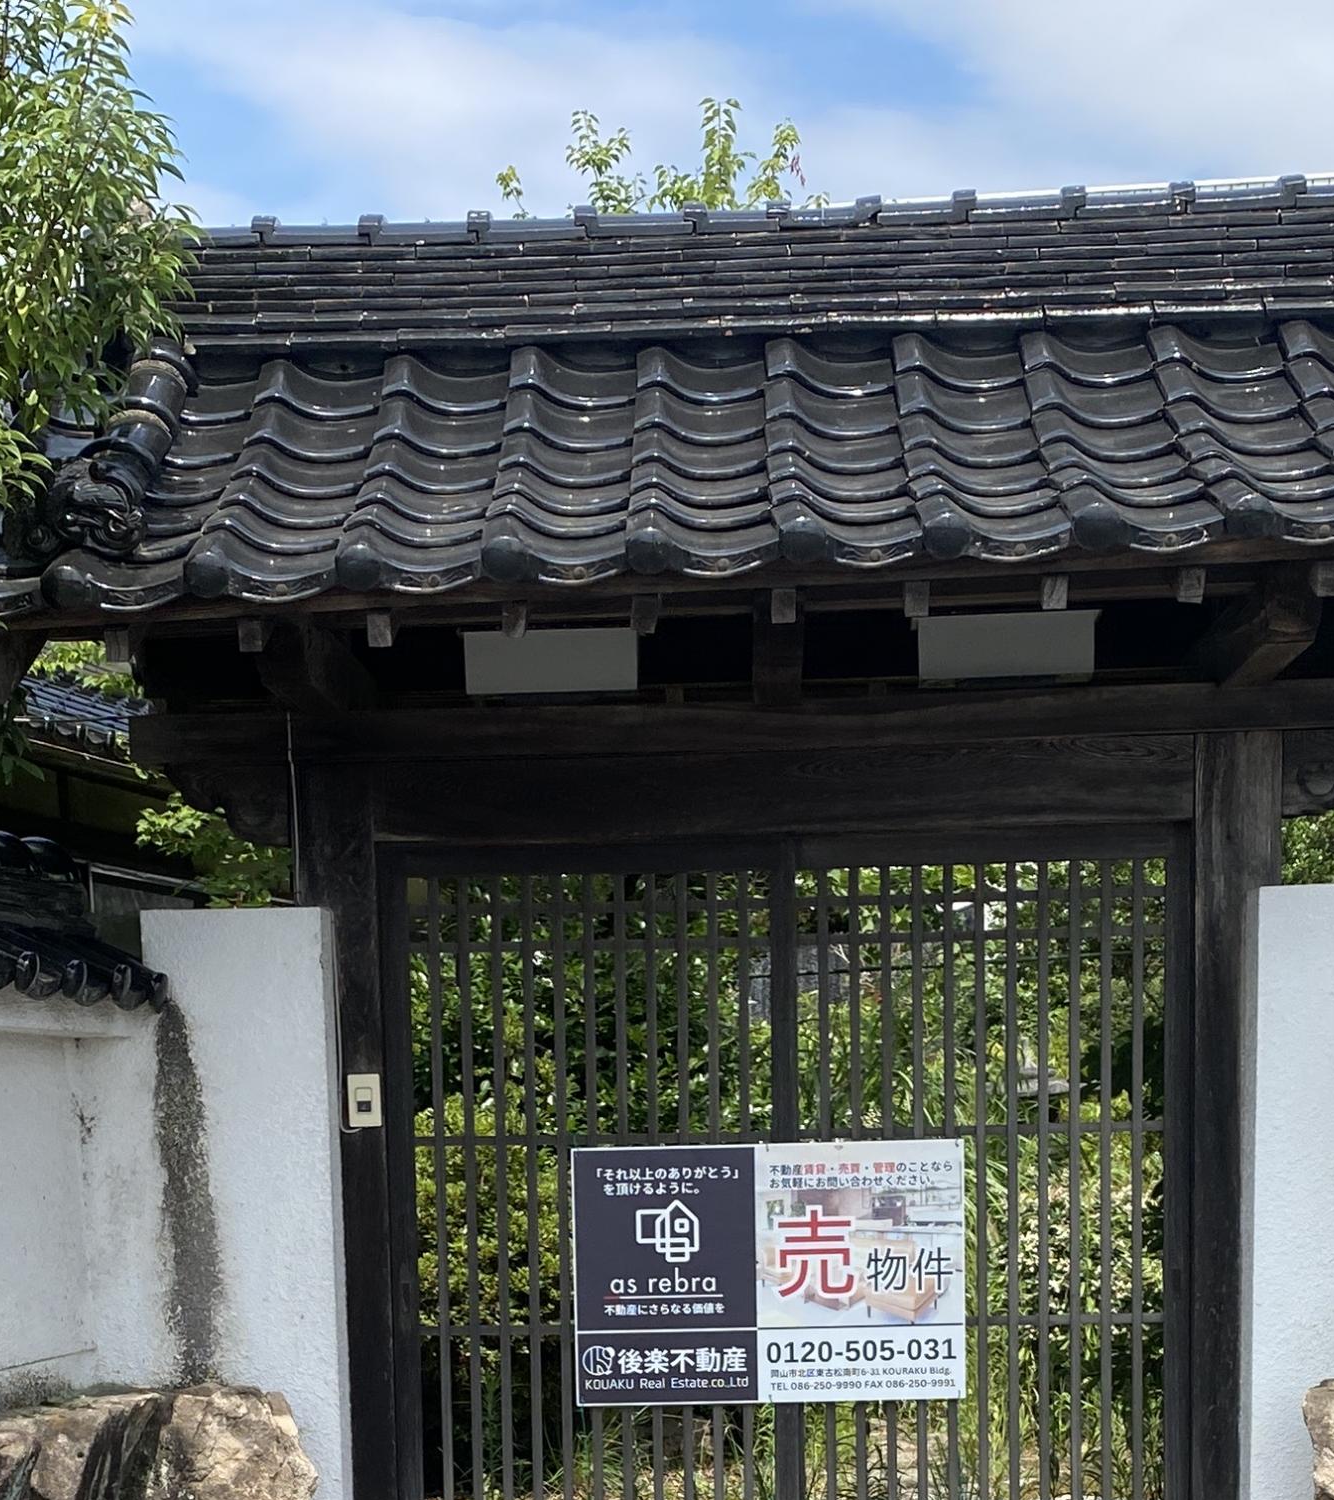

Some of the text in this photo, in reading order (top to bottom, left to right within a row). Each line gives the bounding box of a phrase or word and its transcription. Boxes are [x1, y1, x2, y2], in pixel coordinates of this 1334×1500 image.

[595, 1167, 739, 1181] 「それ以上のありがとう」
[769, 1161, 953, 1175] 不動産賃貸・売買・管理のことなら
[603, 1182, 700, 1196] を頂けるように。
[769, 1175, 935, 1189] お気軽にお問い合わせください。
[610, 1267, 716, 1294] as rebra
[604, 1303, 725, 1316] 不動産にさらなる価値を
[766, 1338, 957, 1363] 0120-505-031
[617, 1346, 748, 1375] 後楽不動産
[882, 1367, 927, 1376] KOURAKU
[640, 1377, 666, 1389] Real
[771, 1379, 956, 1391] TEL 086-250-9990 FAX 086-250-9991
